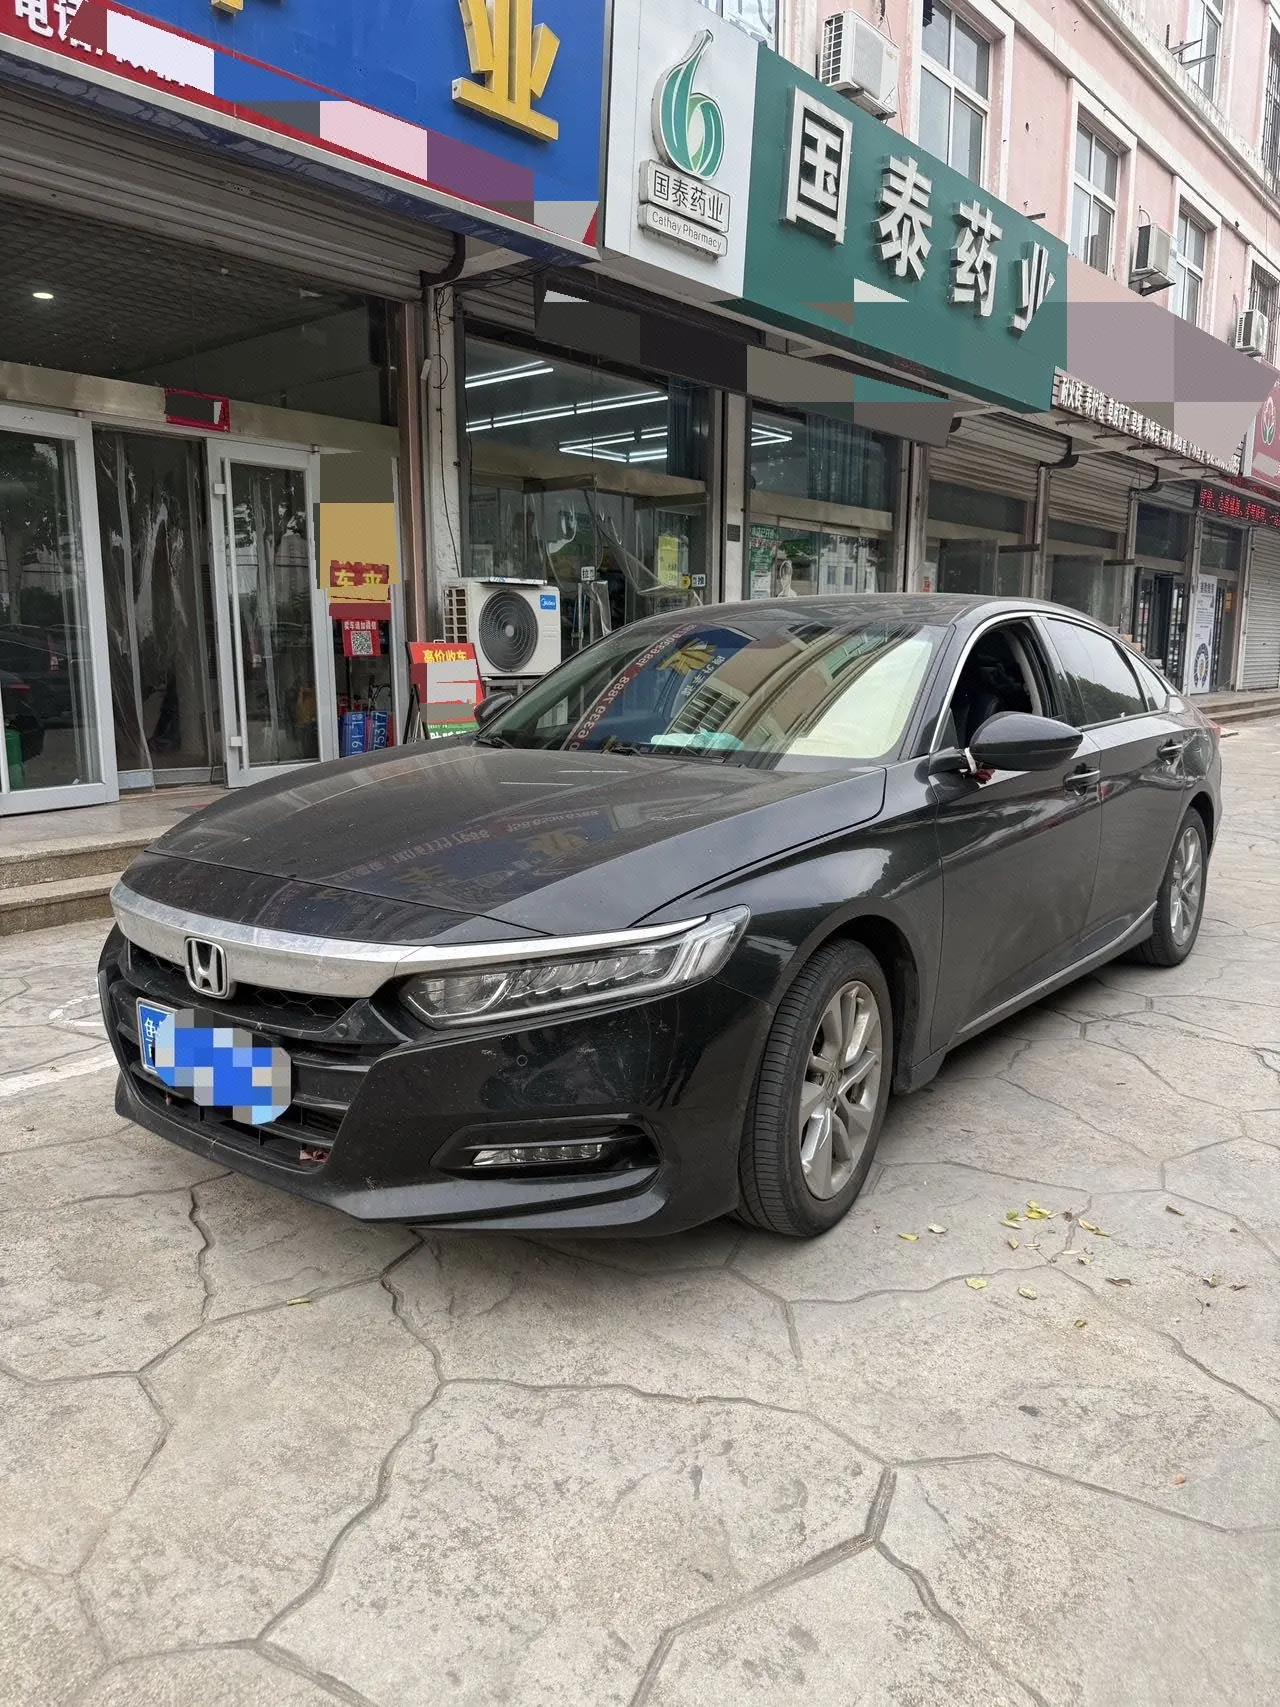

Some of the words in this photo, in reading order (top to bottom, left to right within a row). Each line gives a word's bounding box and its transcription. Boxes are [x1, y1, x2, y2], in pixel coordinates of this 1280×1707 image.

[653, 169, 723, 223] 国泰药业
[652, 211, 681, 235] Cathay
[682, 223, 722, 251] Pharmacy
